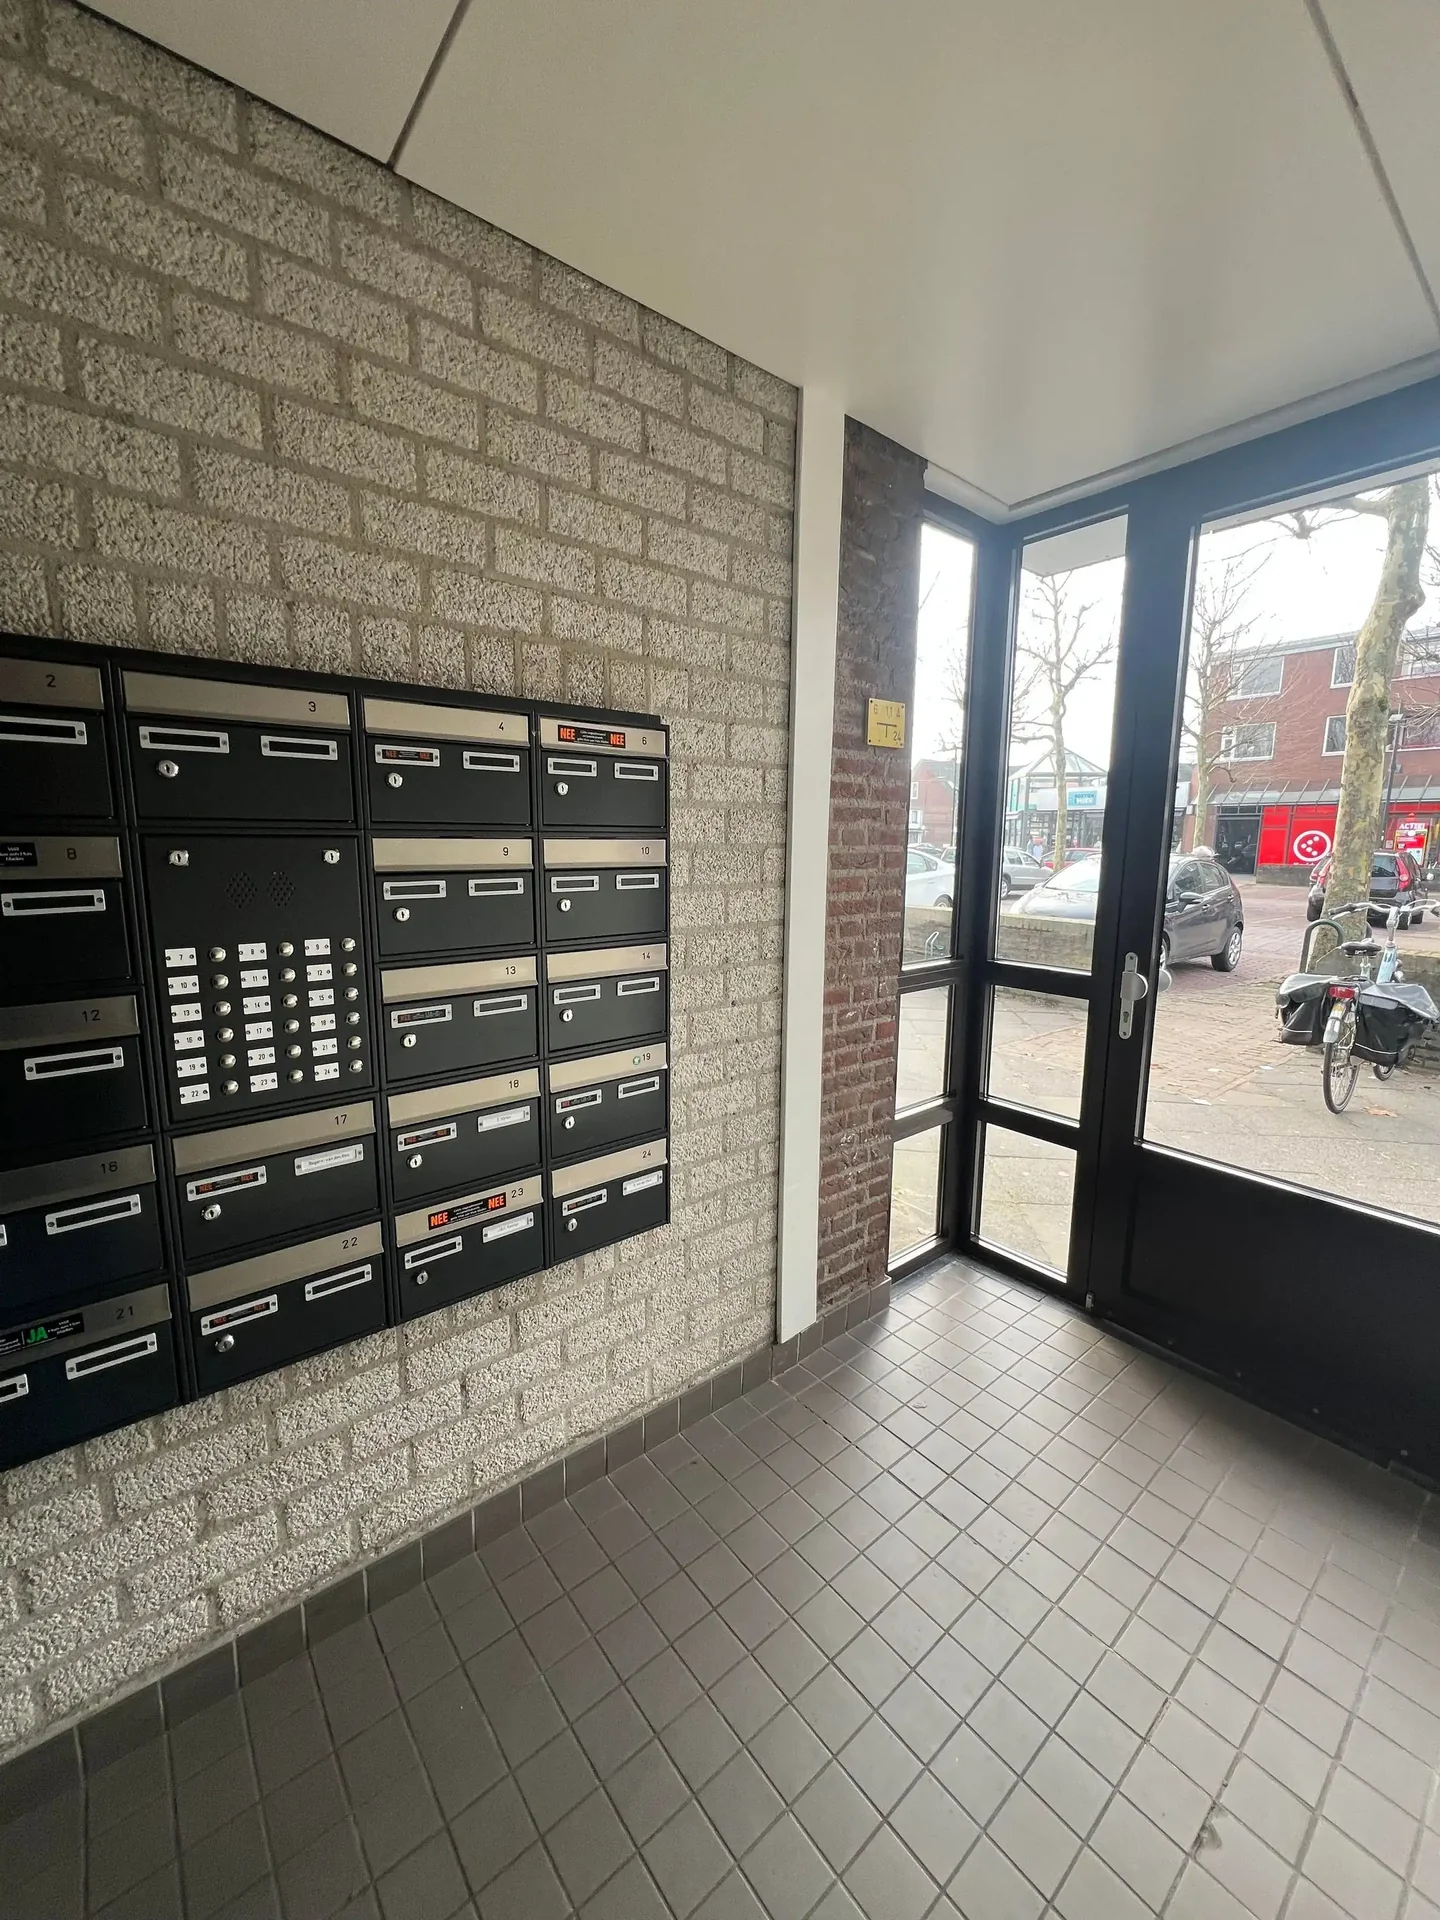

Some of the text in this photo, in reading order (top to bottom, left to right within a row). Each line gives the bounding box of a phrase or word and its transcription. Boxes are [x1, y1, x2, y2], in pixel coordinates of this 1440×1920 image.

[45, 675, 56, 688] 2
[308, 701, 316, 712] 3
[499, 723, 504, 731] 4
[560, 728, 575, 740] NEE
[610, 734, 624, 745] NEE
[642, 737, 647, 746] 6
[67, 848, 77, 860] 8
[503, 847, 509, 857] 9
[641, 847, 650, 855] 10
[505, 967, 516, 975] 13
[82, 1010, 101, 1022] 12
[642, 1053, 651, 1061] 19
[509, 1080, 519, 1089] 18
[334, 1114, 348, 1125] 17
[642, 1150, 651, 1158] 24
[101, 1161, 118, 1174] 16
[512, 1188, 524, 1198] 23
[488, 1196, 504, 1209] NEE
[431, 1212, 448, 1226] NEE
[342, 1237, 358, 1250] 22
[116, 1306, 134, 1320] 21
[27, 1327, 48, 1344] JA
